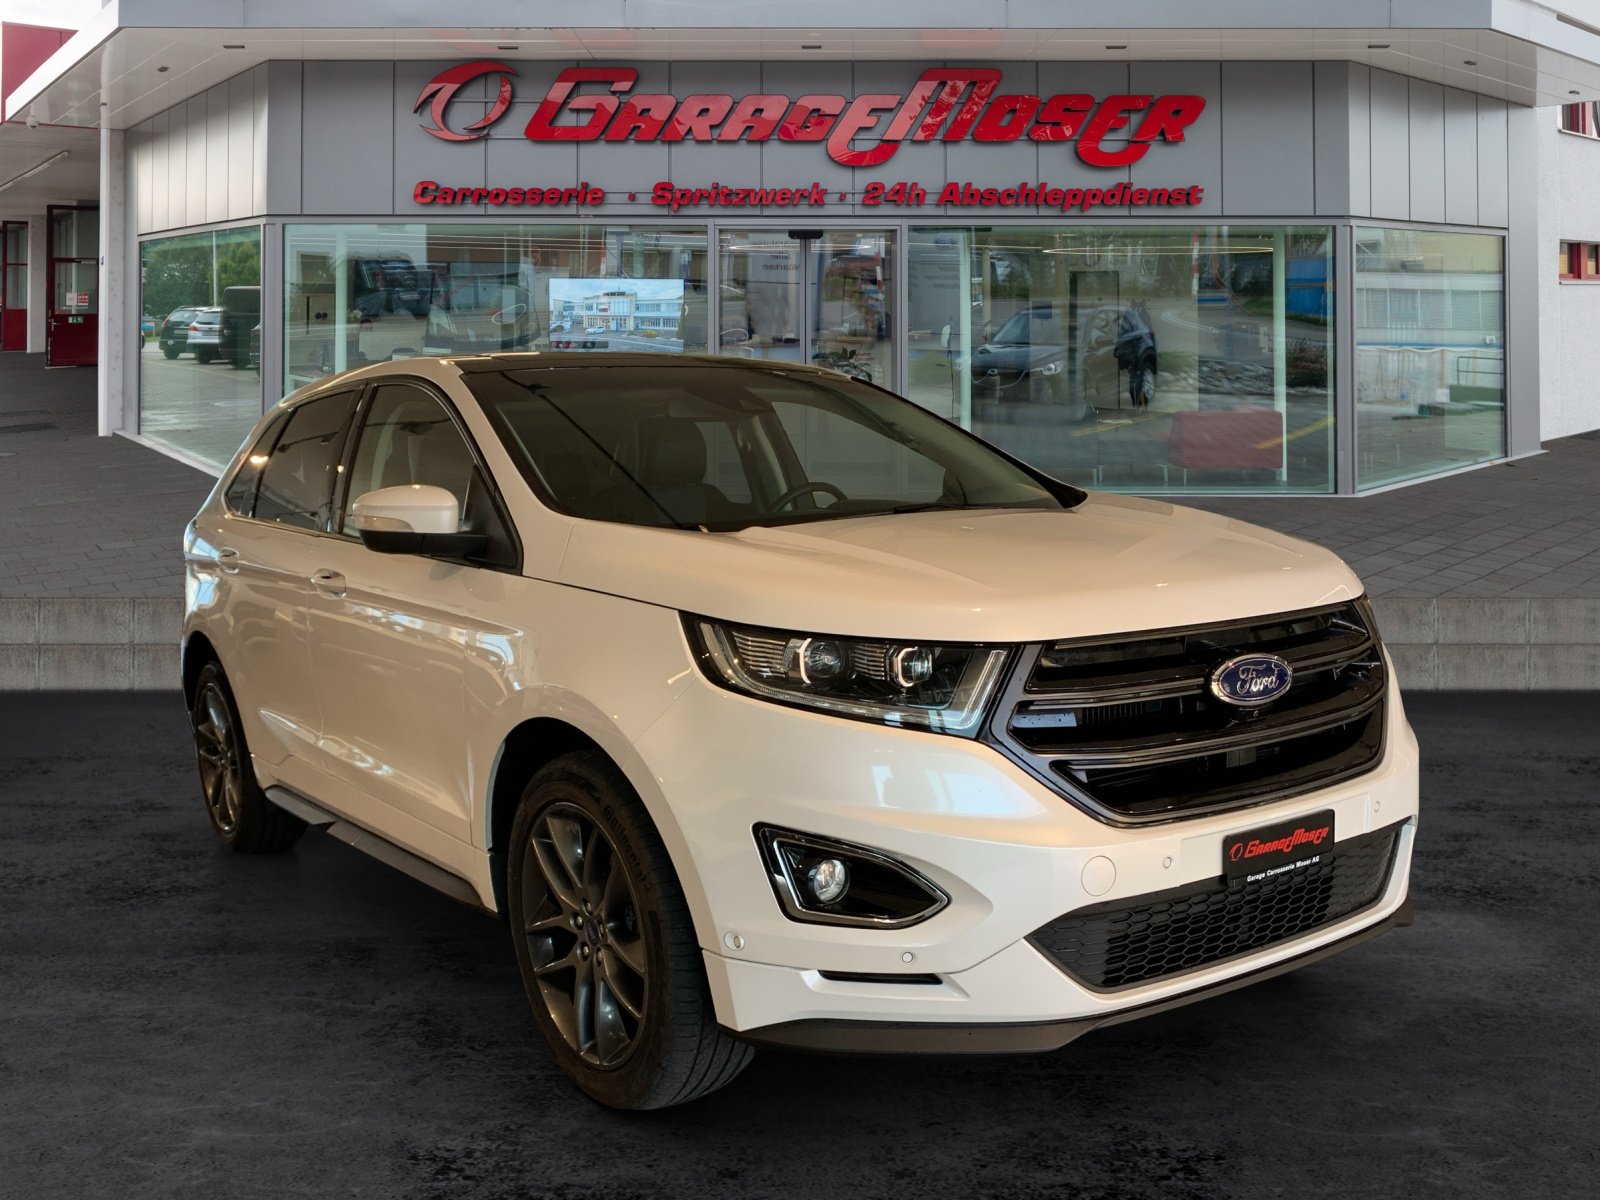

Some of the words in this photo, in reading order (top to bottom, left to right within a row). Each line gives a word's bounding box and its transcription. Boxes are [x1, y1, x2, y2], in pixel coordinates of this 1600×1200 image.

[413, 181, 605, 206] Carrosserie
[651, 181, 826, 212] Spritzwerk
[861, 181, 927, 206] 24h
[936, 181, 1204, 212] Abschleppdienst
[1236, 662, 1281, 695] Ford
[1247, 872, 1266, 882] Garage
[1266, 863, 1296, 876] Carrosserie
[1296, 859, 1312, 868] Moser
[1311, 855, 1320, 864] AG
